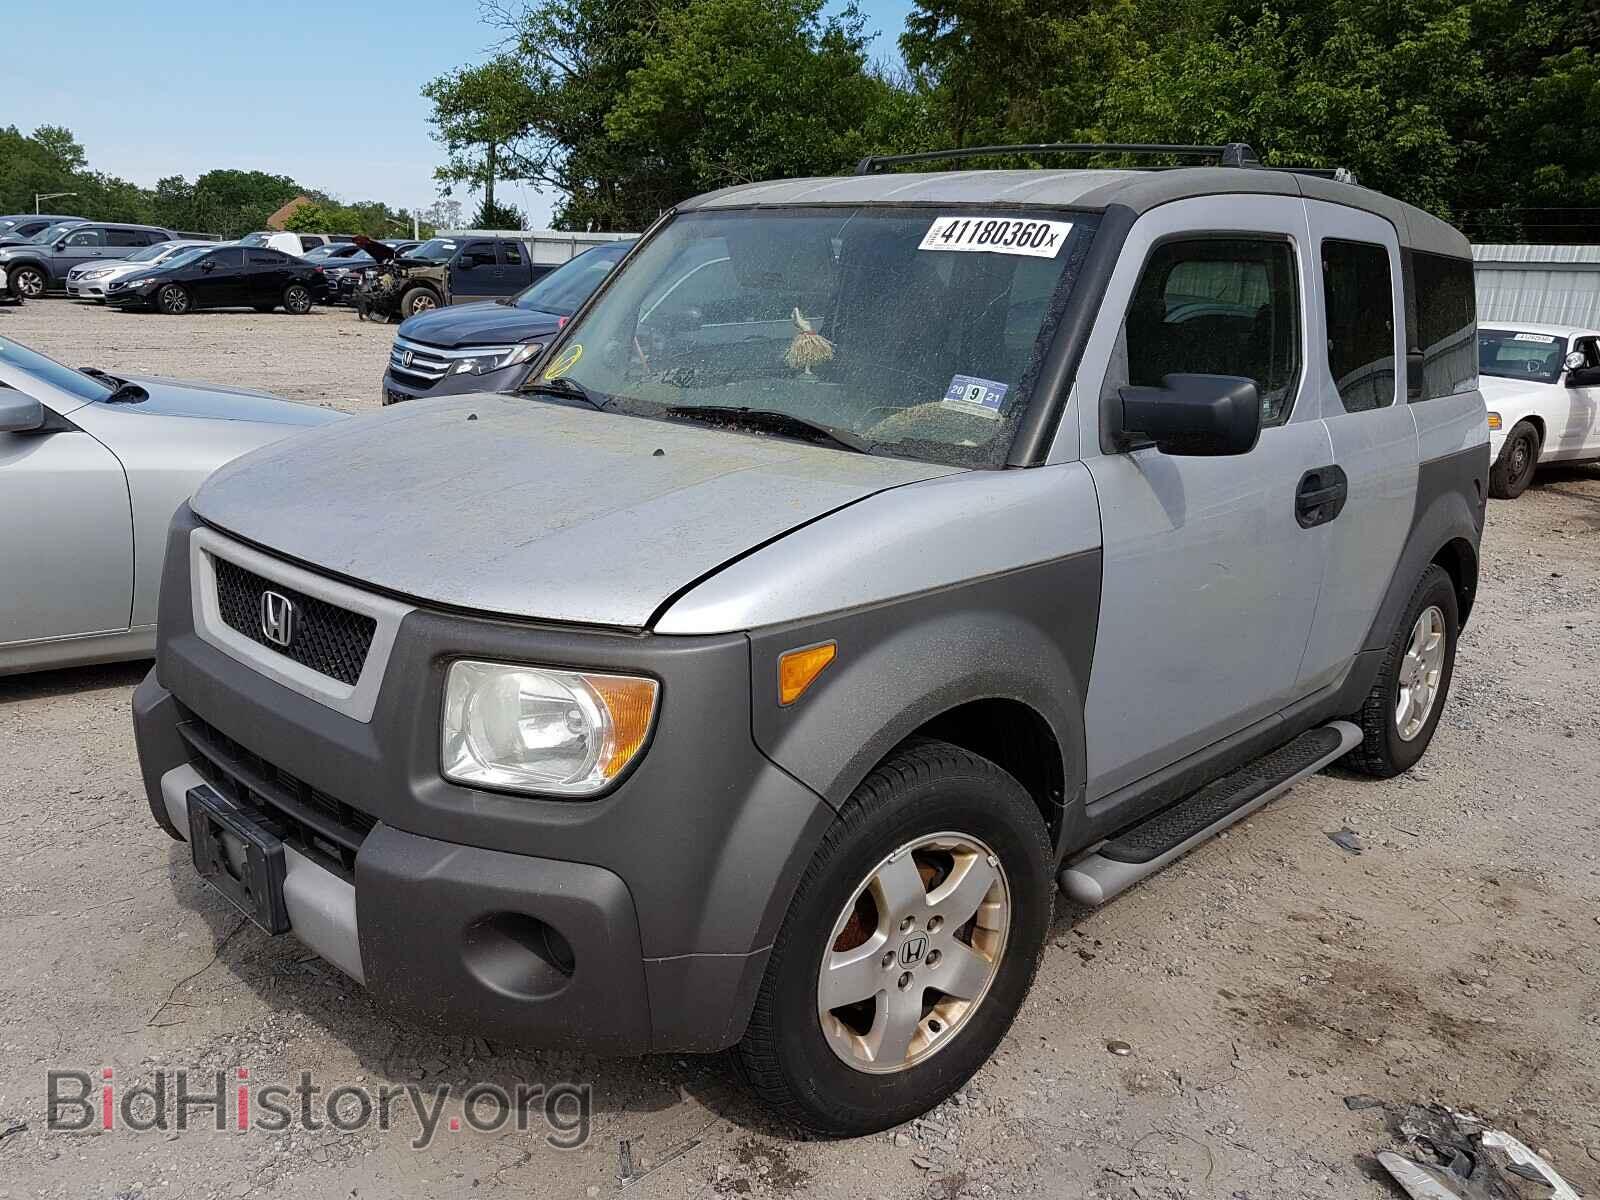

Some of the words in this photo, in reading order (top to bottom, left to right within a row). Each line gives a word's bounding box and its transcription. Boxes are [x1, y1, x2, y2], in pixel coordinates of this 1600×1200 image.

[951, 385, 964, 395] 20
[969, 387, 979, 401] 9
[985, 392, 1000, 403] 21
